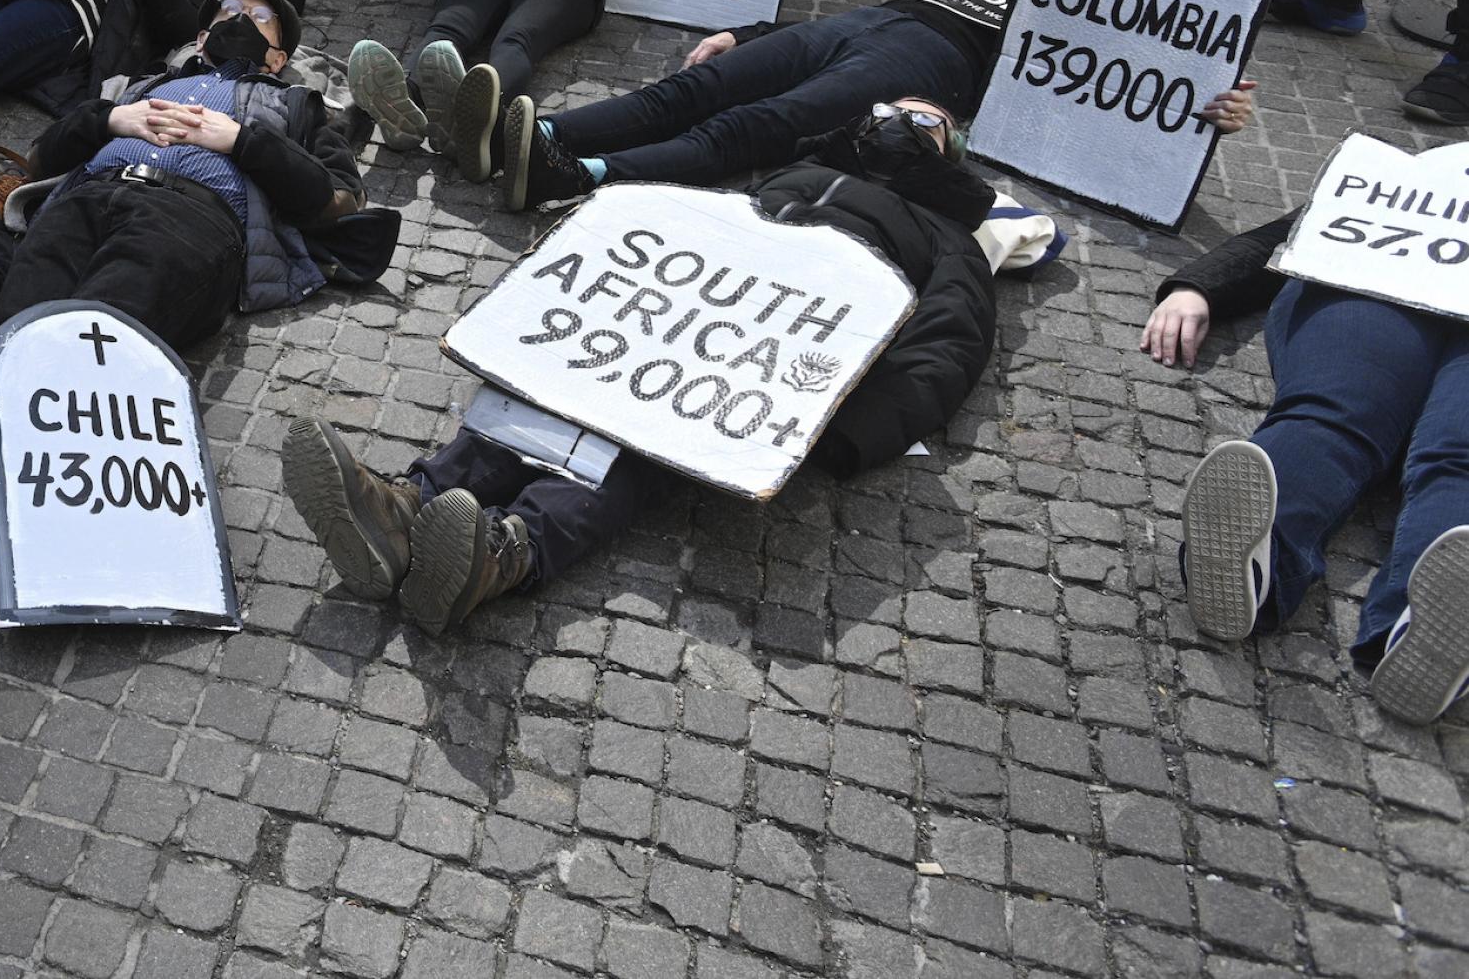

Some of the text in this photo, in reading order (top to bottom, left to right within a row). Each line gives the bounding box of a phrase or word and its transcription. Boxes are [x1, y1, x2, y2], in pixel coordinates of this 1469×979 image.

[962, 0, 984, 13] THE
[532, 252, 780, 383] AFRICA
[607, 229, 852, 343] SOUTH
[29, 388, 182, 445] CHILE
[519, 308, 804, 447] 99,000+
[18, 452, 206, 516] 43,000+
